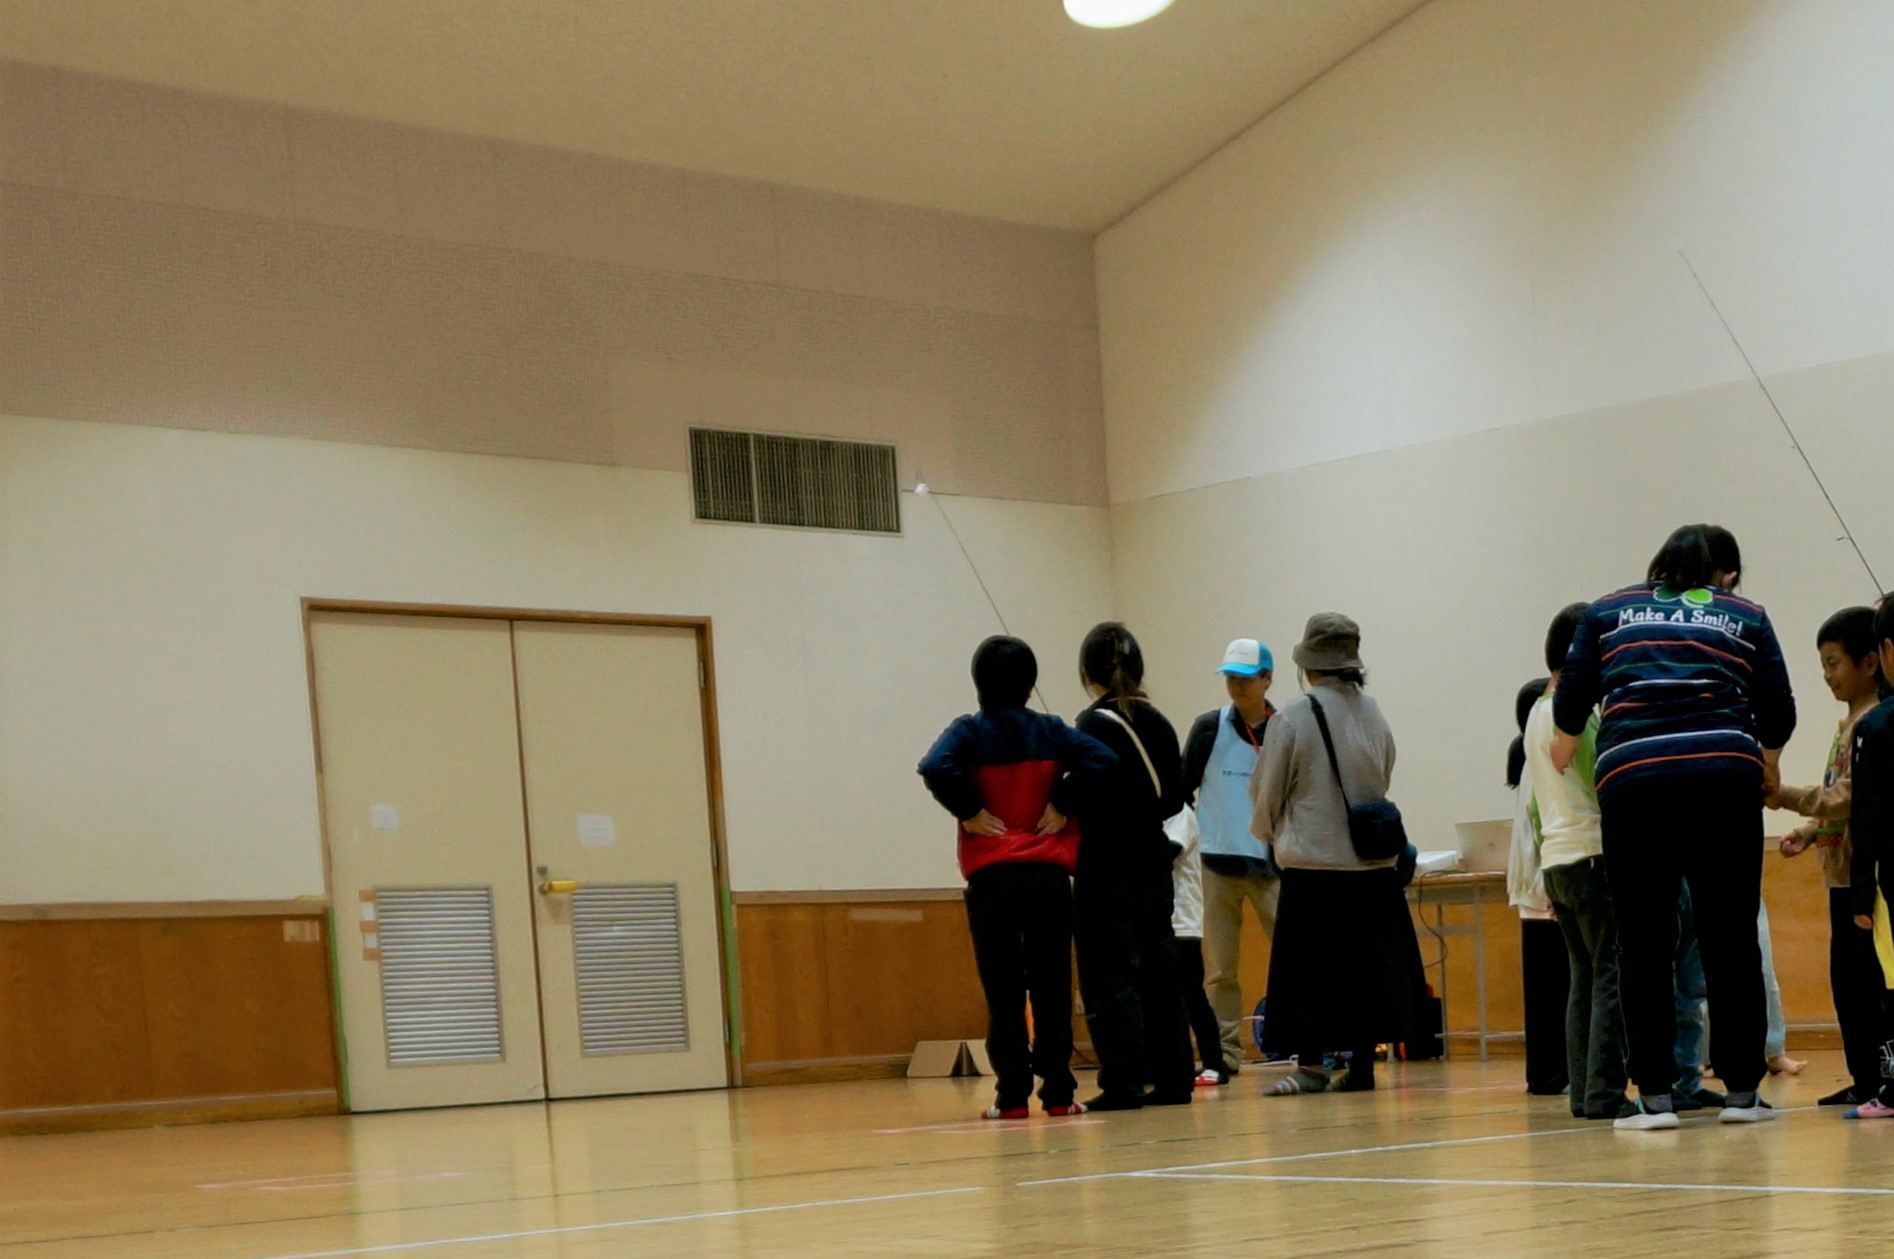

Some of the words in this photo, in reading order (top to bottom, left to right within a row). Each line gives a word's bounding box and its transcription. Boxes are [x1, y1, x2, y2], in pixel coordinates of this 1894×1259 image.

[1618, 607, 1665, 628] Make
[1670, 609, 1684, 623] A
[1690, 610, 1743, 637] Smile!
